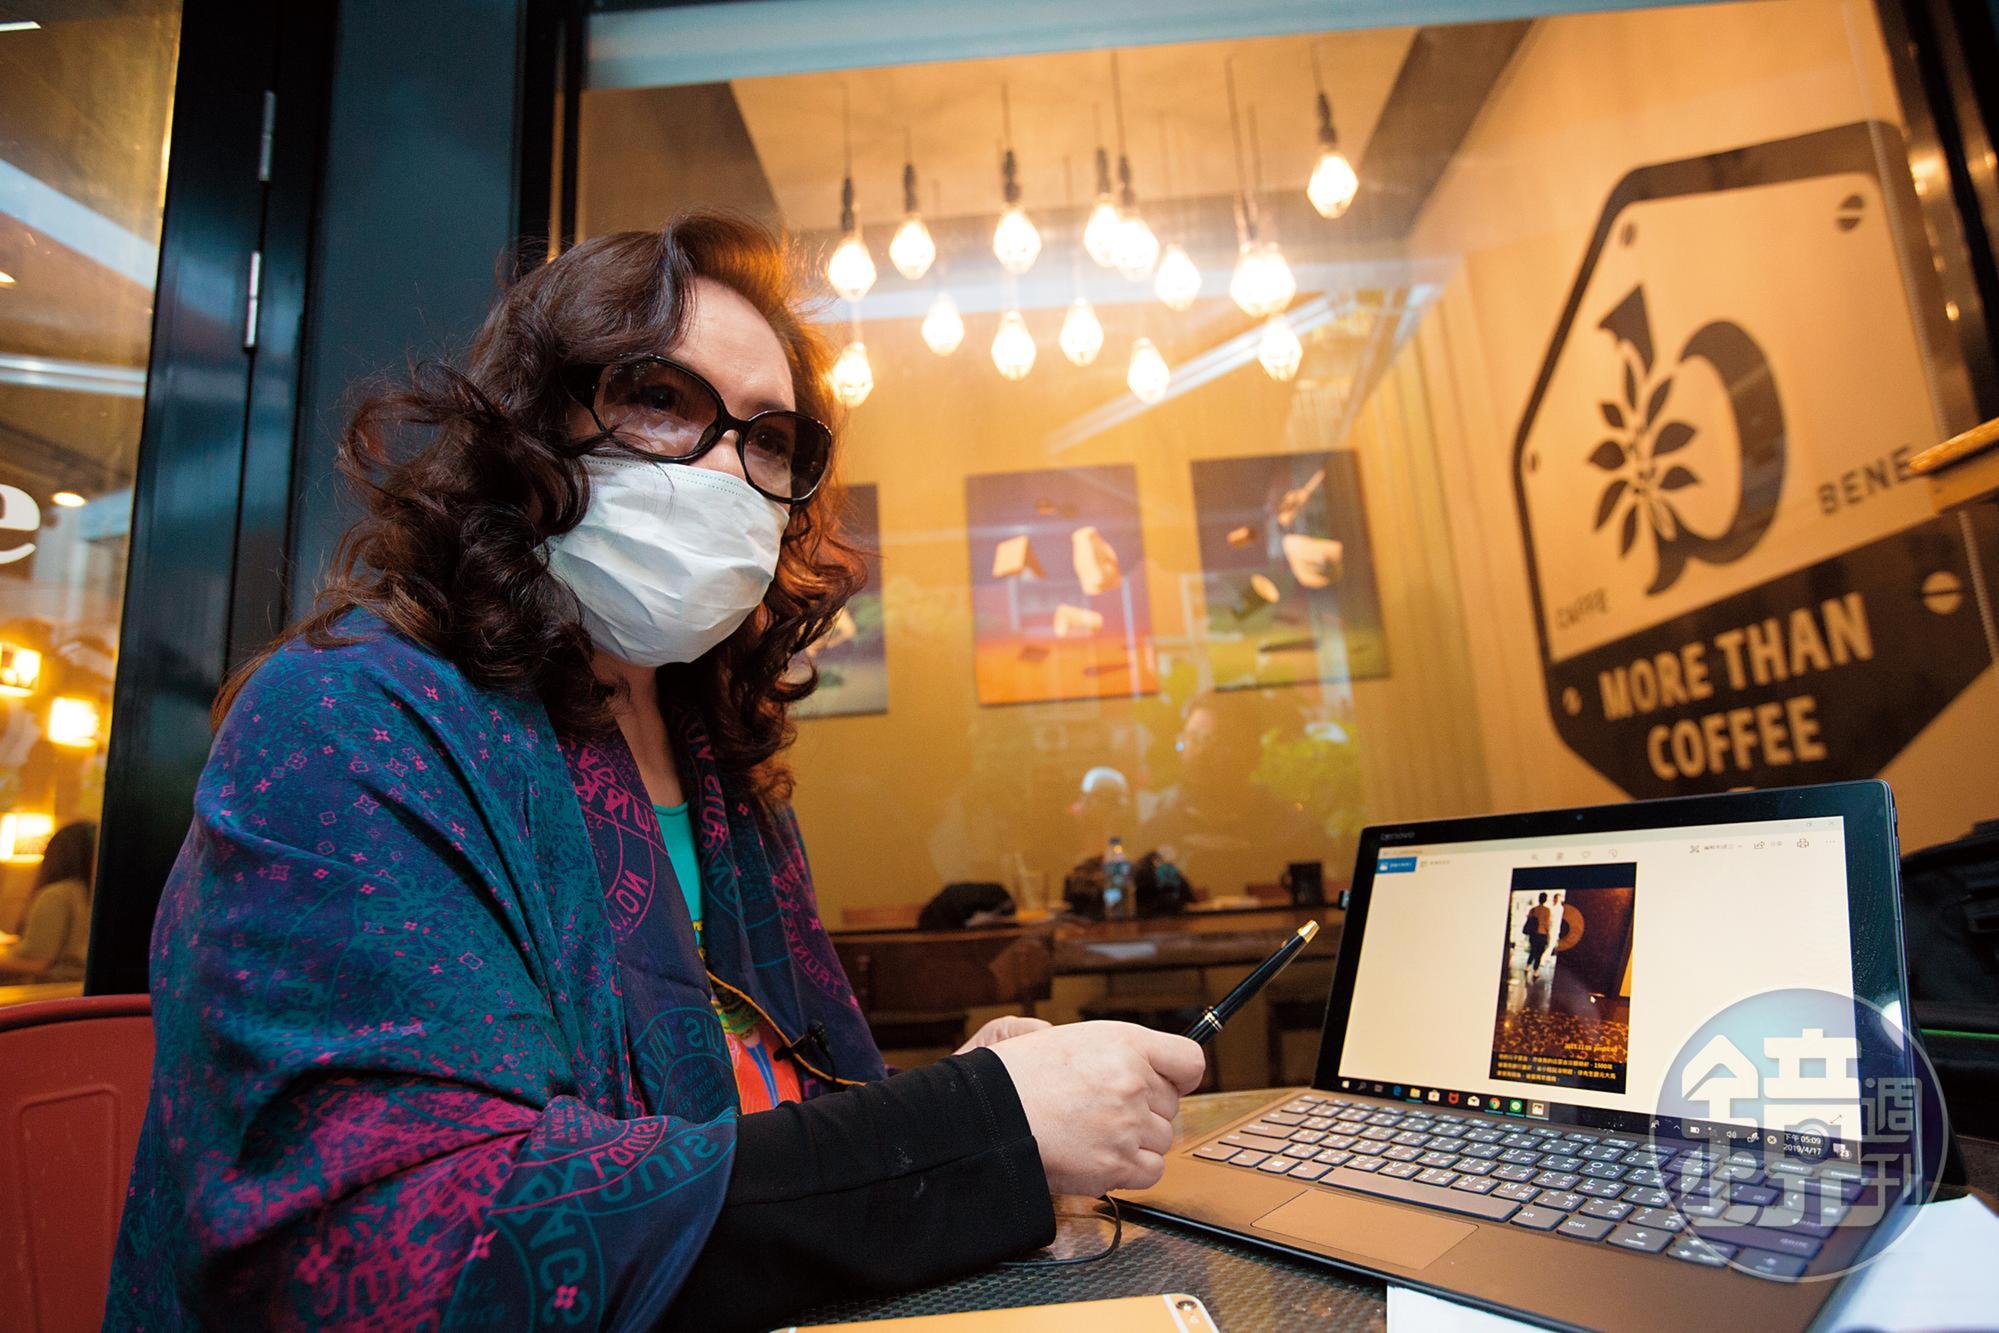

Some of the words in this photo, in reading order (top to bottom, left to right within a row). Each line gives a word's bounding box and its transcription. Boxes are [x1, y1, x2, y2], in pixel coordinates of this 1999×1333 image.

[1818, 444, 1913, 515] BENE
[1599, 641, 1715, 720] MORE
[1714, 591, 1874, 692] THAN
[1649, 696, 1828, 780] COFFEE
[1783, 1144, 1822, 1155] 2019/4/17
[1800, 1135, 1822, 1145] 05:09
